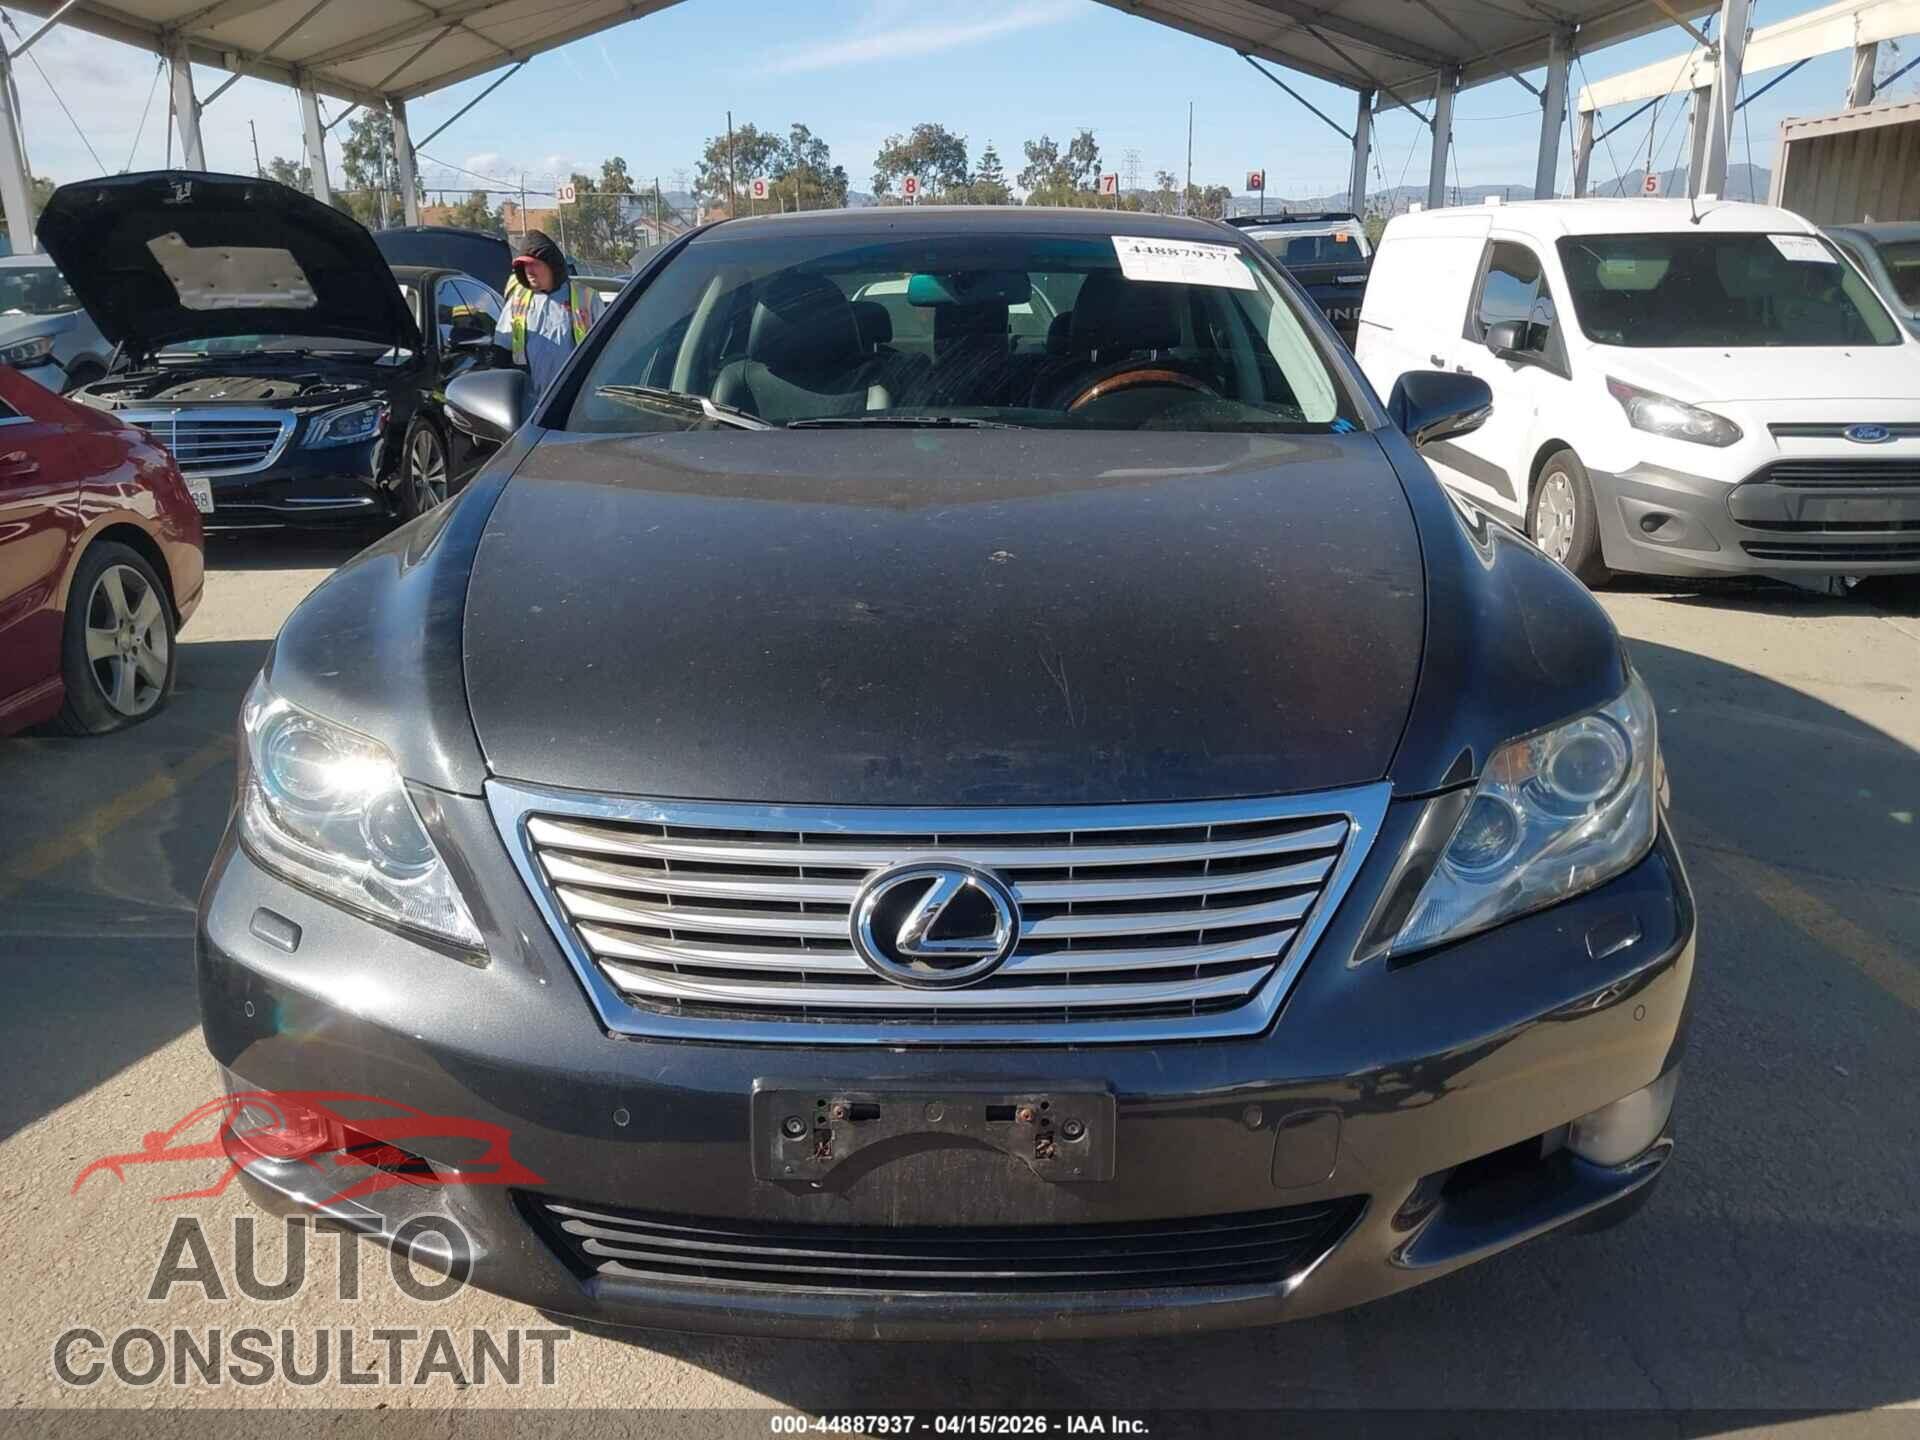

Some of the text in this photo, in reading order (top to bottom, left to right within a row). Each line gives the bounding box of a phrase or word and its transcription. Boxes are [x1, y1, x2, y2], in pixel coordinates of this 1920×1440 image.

[754, 181, 763, 196] 9
[906, 178, 915, 193] 8
[1104, 176, 1114, 192] 7
[1251, 174, 1260, 188] 6
[1646, 176, 1656, 192] 5
[557, 187, 573, 200] 10
[1129, 245, 1228, 262] 44887937
